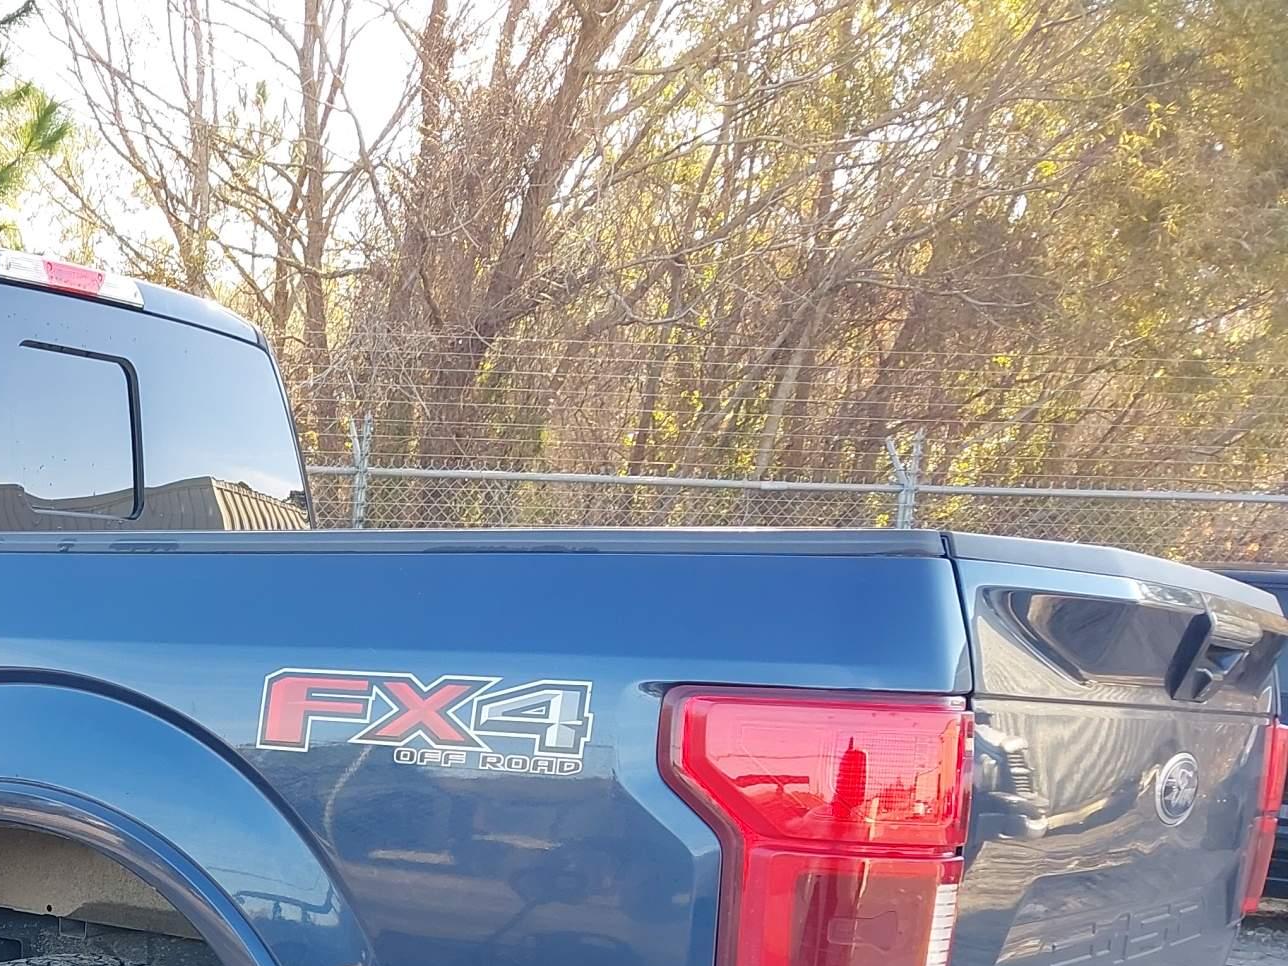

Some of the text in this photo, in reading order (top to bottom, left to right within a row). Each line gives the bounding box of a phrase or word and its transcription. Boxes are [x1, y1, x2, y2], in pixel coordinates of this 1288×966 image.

[256, 667, 594, 758] FX4
[393, 747, 583, 775] OFF ROAD
